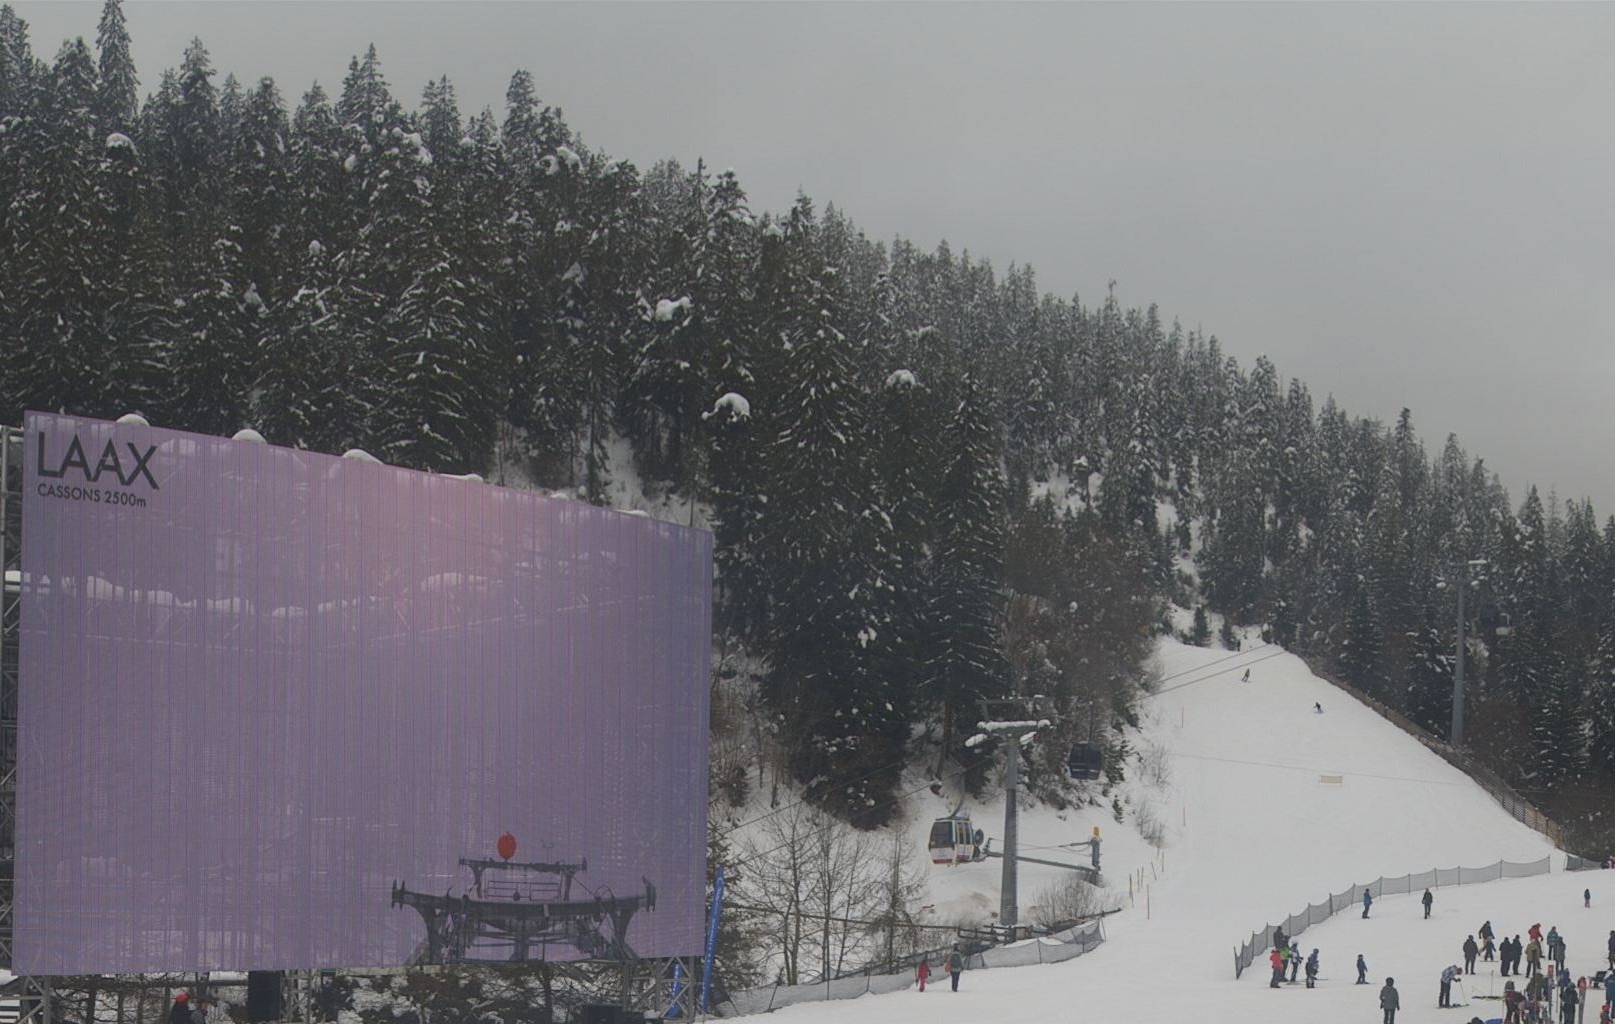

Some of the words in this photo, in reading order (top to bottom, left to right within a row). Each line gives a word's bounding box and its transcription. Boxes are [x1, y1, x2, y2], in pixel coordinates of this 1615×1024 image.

[37, 431, 160, 490] LAAX
[37, 483, 101, 503] CASSONS
[104, 490, 147, 508] 2500m
